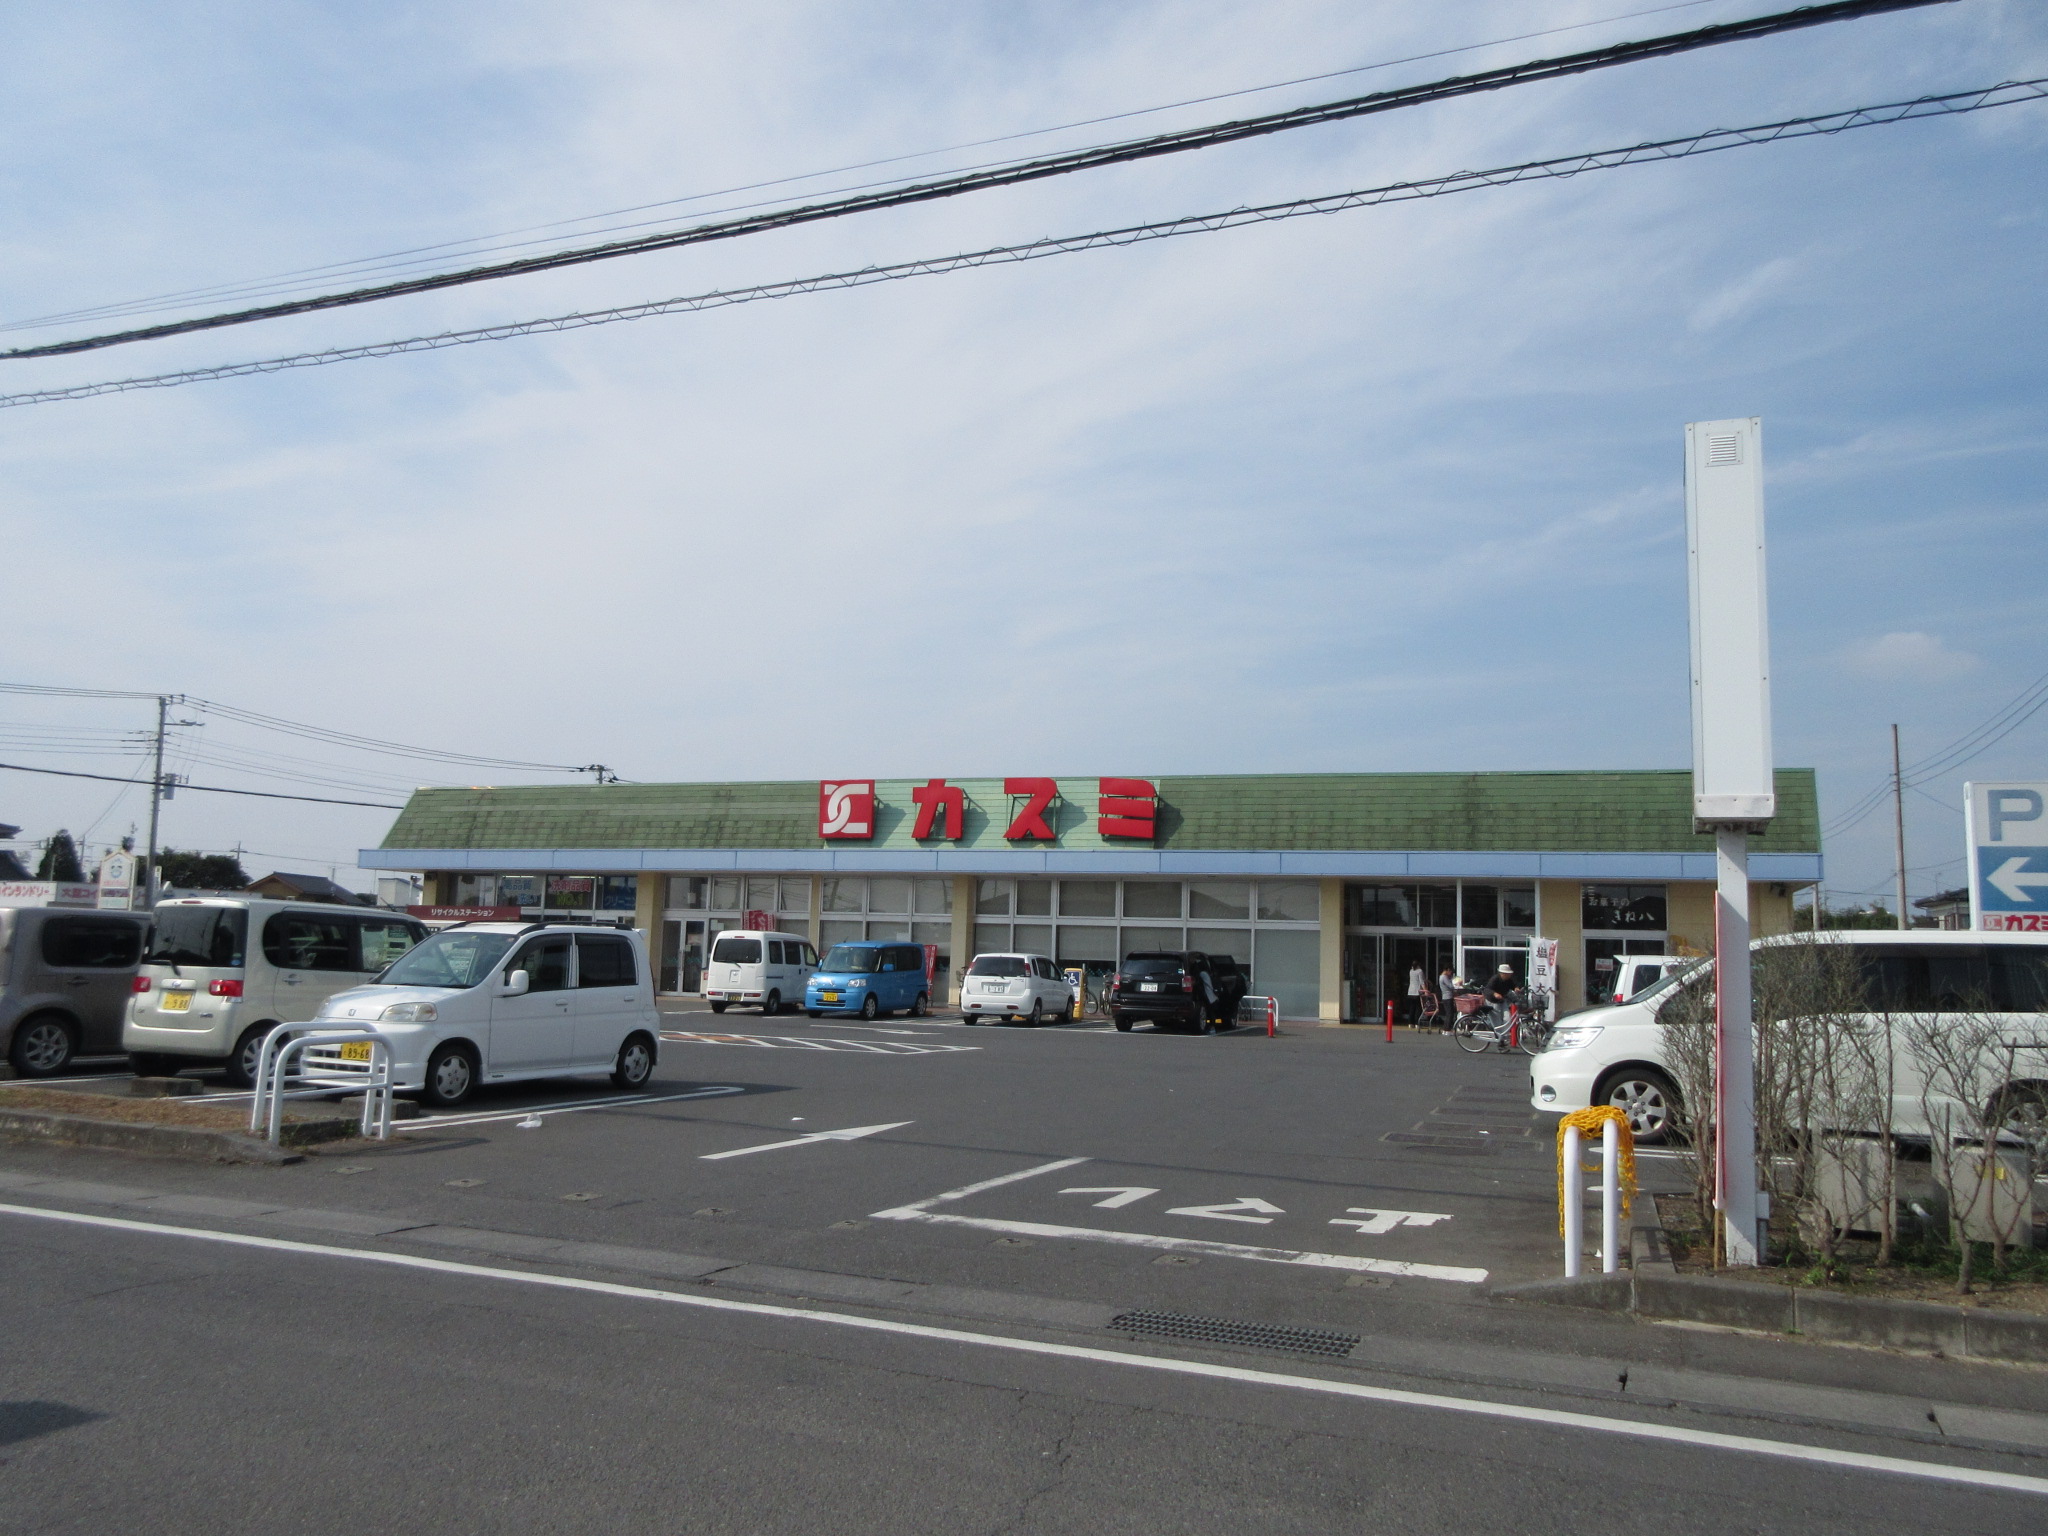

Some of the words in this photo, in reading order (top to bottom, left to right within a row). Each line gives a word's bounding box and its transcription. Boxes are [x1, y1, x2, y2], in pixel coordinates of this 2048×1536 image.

[911, 777, 1157, 840] カスミ
[1987, 789, 2044, 841] P
[0, 884, 50, 898] インランドリー
[430, 908, 495, 917] リサイクルステーション
